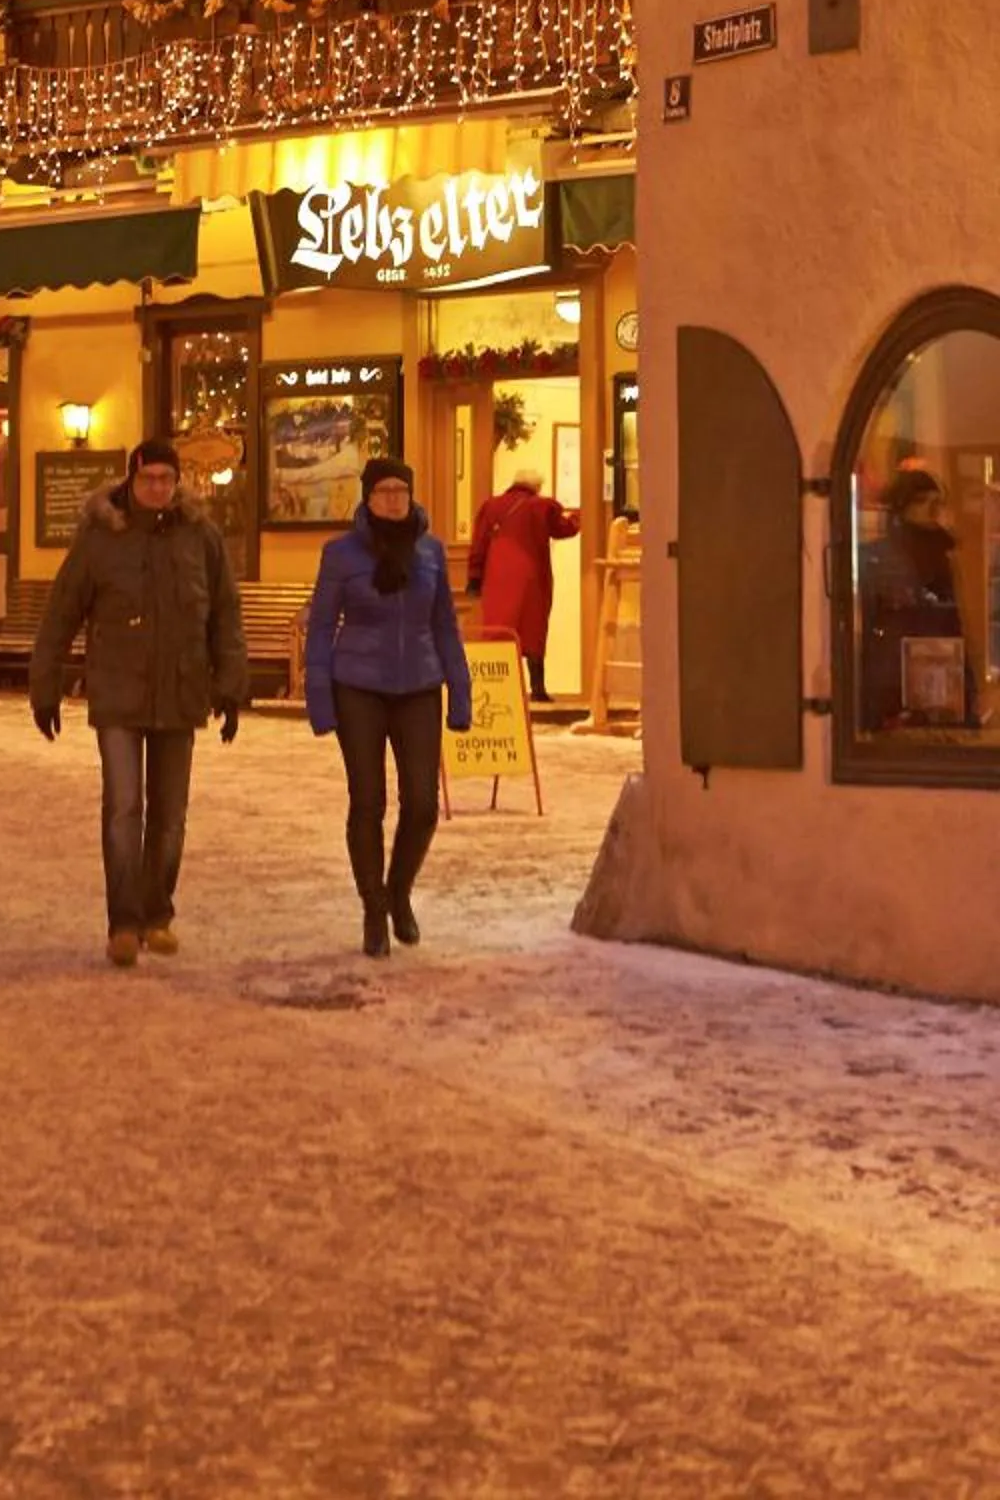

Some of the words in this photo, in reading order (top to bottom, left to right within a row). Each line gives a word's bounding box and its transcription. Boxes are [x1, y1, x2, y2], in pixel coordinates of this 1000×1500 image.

[703, 15, 762, 52] Stadtplatz
[290, 167, 545, 280] Lebzelter
[457, 750, 517, 762] OPEN
